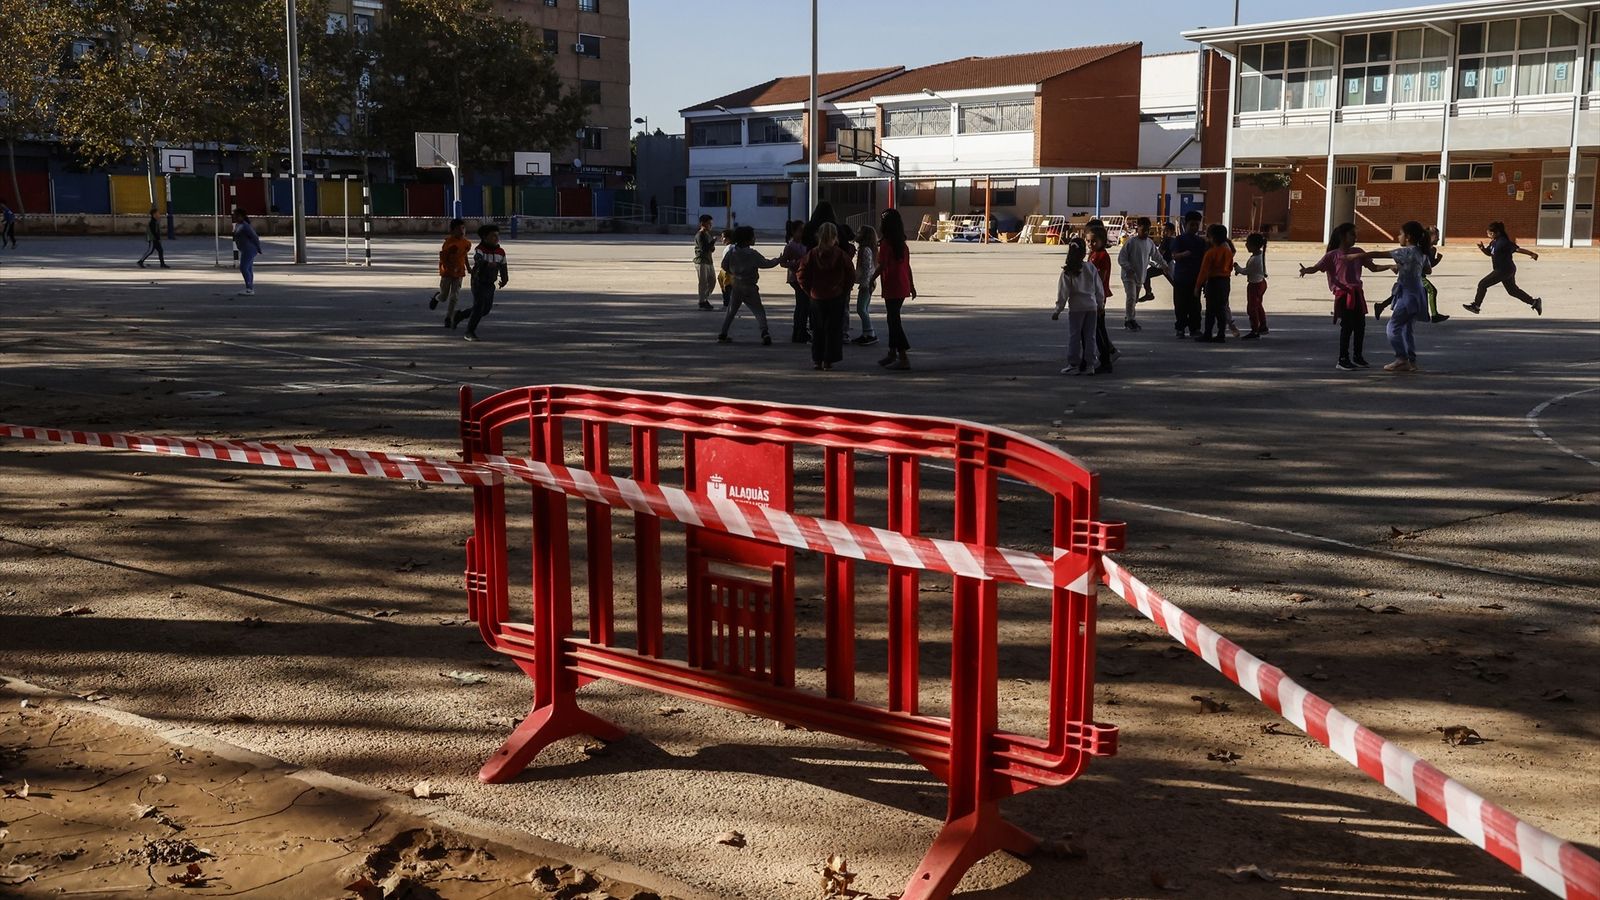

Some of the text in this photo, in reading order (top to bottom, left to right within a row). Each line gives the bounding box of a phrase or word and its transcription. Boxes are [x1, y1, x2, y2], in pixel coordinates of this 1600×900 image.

[1350, 80, 1357, 91] A
[1375, 78, 1383, 90] L
[1403, 78, 1412, 90] A
[1429, 75, 1438, 87] B
[1466, 74, 1474, 84] A
[1495, 69, 1504, 82] U
[729, 485, 769, 502] ALAQUÀS
